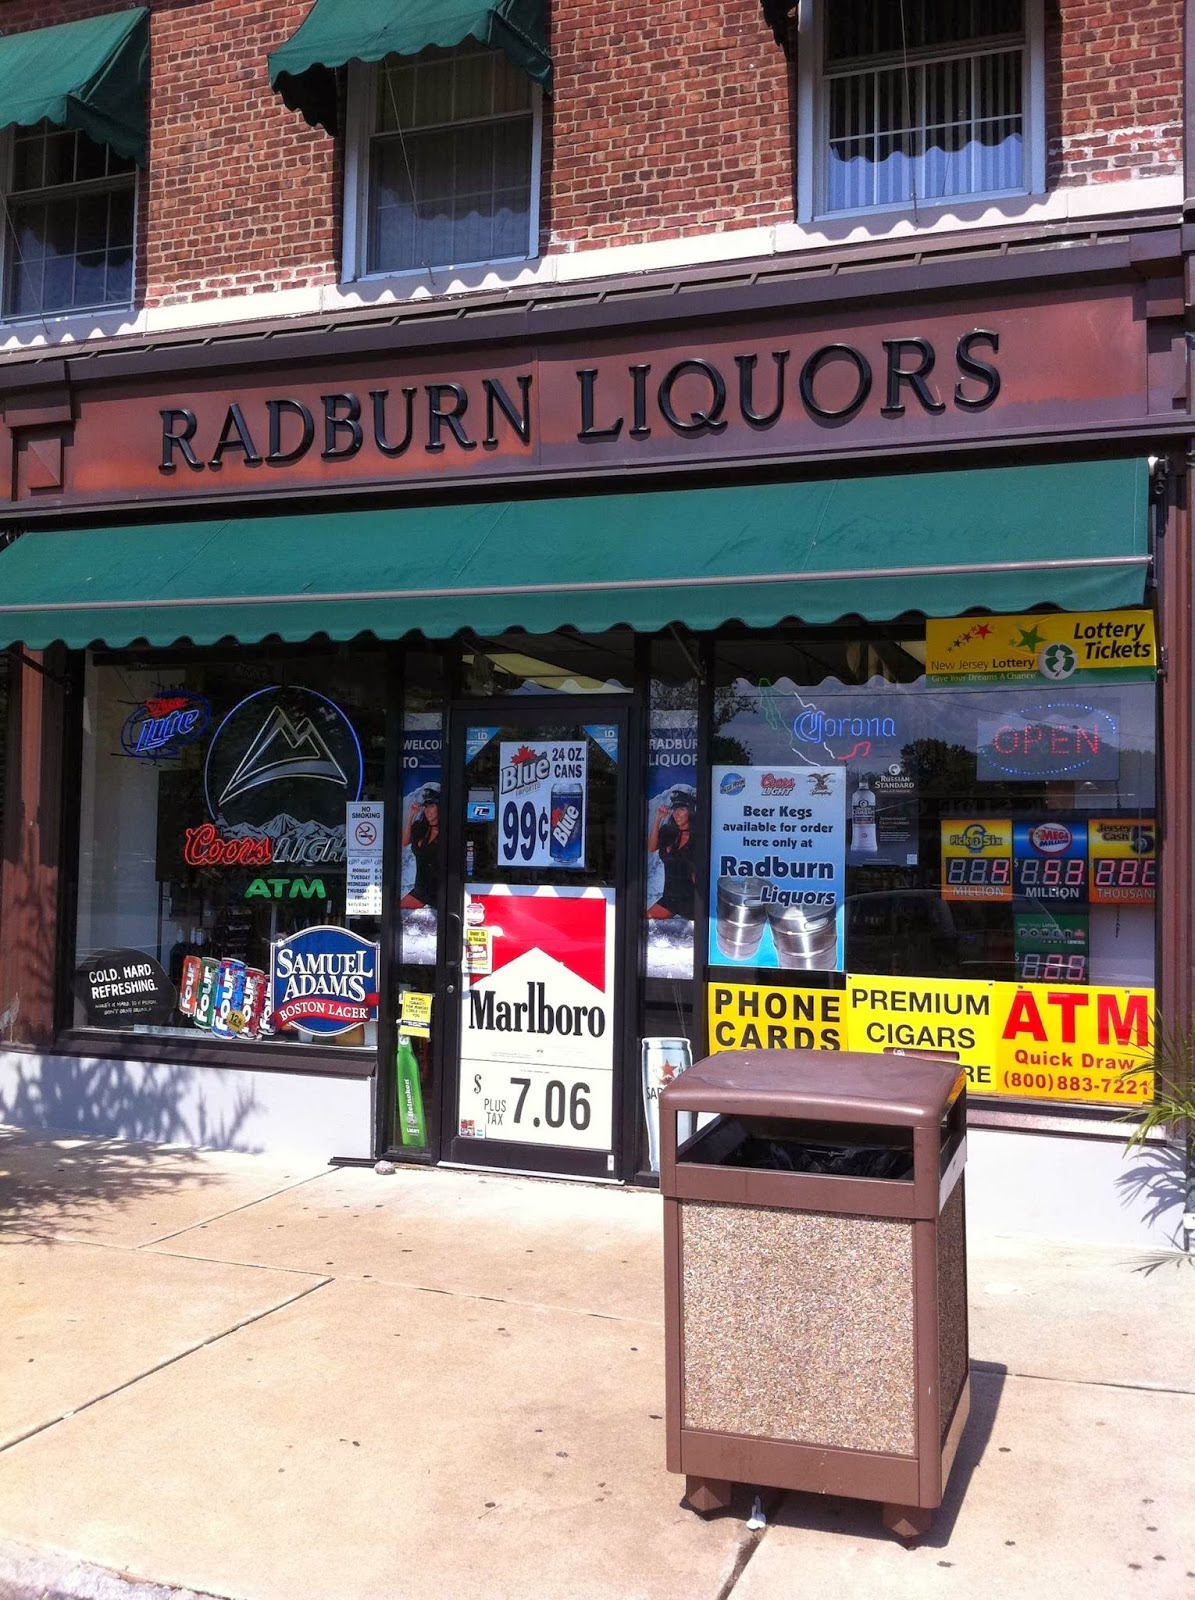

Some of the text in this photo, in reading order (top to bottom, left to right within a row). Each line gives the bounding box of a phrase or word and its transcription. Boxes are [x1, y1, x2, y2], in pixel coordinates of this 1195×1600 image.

[158, 328, 1000, 472] RADBURN LIQUORS
[1074, 622, 1145, 640] Lottery
[1085, 641, 1151, 660] Tickets
[931, 659, 1034, 671] New Jersey Lottery
[793, 711, 896, 743] Corona
[993, 724, 1099, 755] OPEN
[403, 757, 419, 768] TO
[552, 748, 585, 762] 24 OZ.
[501, 757, 550, 795] Blue
[554, 764, 582, 778] CANS
[761, 773, 795, 788] Coors
[761, 787, 793, 796] LIGHT
[743, 806, 812, 820] Beer Kegs
[503, 801, 549, 861] 99¢
[553, 805, 580, 848] Blue
[723, 821, 833, 833] available for order
[1040, 829, 1068, 840] MEGA
[1102, 832, 1129, 841] Cash
[184, 823, 272, 865] Coors
[743, 837, 813, 850] here only at
[949, 834, 1003, 846] Pick Six
[720, 855, 834, 880] Radburn
[244, 878, 326, 898] ATM
[760, 886, 835, 907] Liquors
[953, 886, 1004, 897] MILLION
[1025, 887, 1080, 898] MILLION
[1097, 889, 1155, 899] THOUSAN
[276, 948, 373, 978] SAMUEL
[89, 963, 154, 984] COLD. HARD.
[91, 979, 158, 999] REFRESHING.
[282, 974, 366, 1002] ADAMS
[279, 1002, 368, 1021] BOSTON LAGER
[469, 981, 605, 1038] Marlboro
[715, 988, 841, 1022] PHONE
[852, 988, 990, 1016] PREMIUM
[1002, 990, 1149, 1047] ATM
[715, 1021, 841, 1050] CARDS
[866, 1022, 976, 1049] CIGARS
[1014, 1050, 1135, 1071] Quick Draw
[474, 1074, 591, 1130] $ 7.06
[484, 1098, 506, 1113] PLUS
[486, 1112, 503, 1126] TAX
